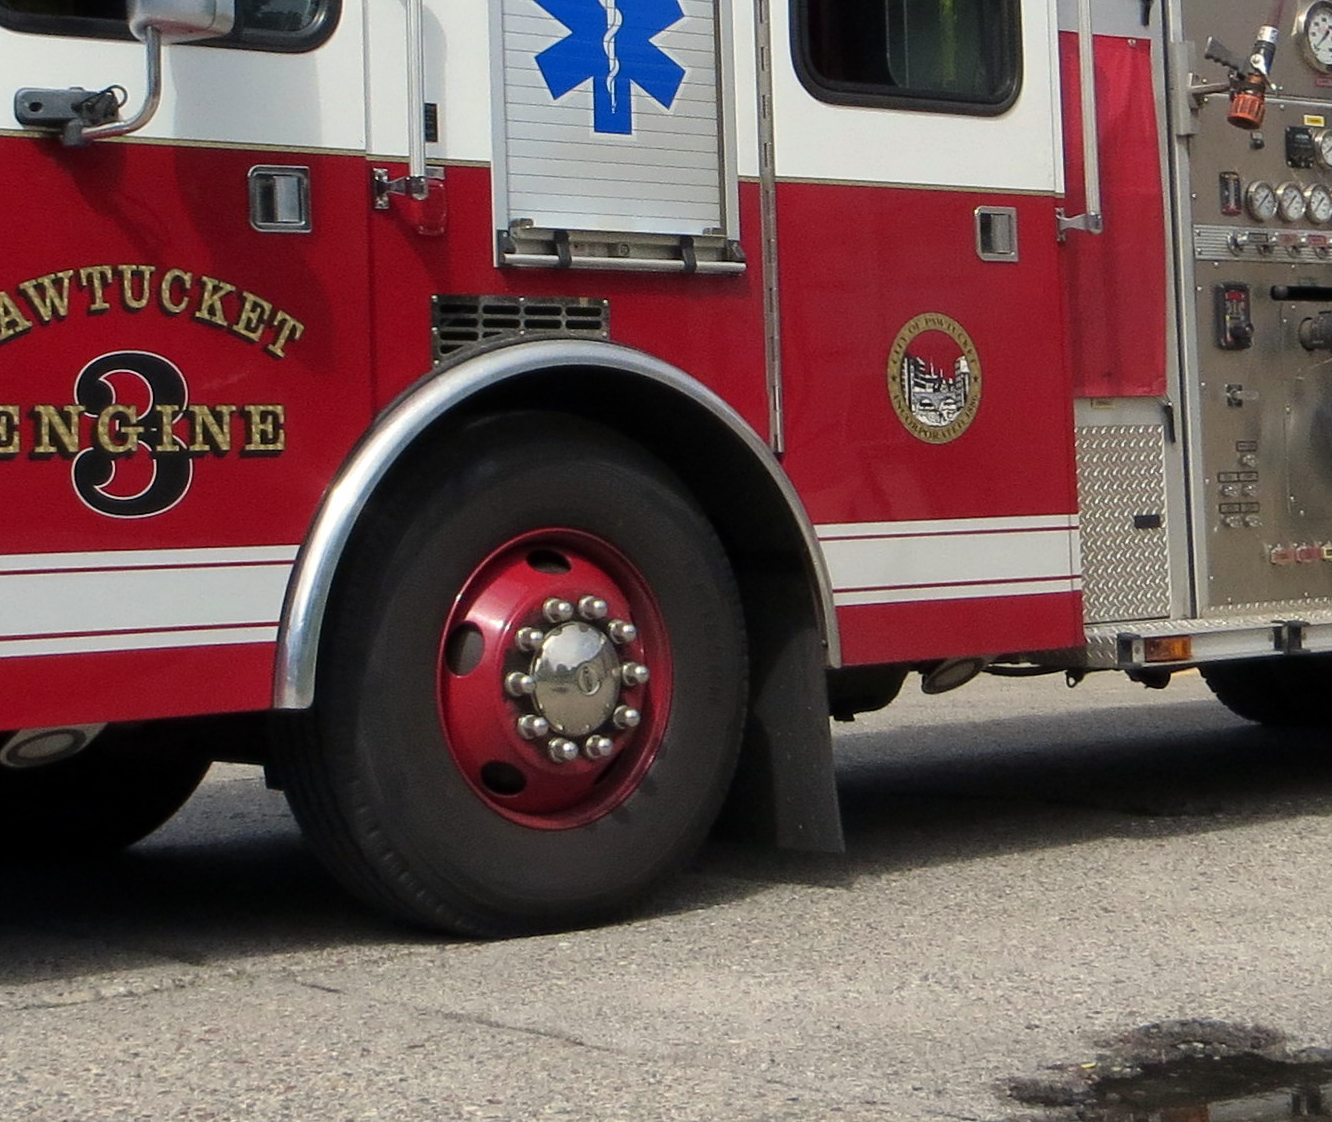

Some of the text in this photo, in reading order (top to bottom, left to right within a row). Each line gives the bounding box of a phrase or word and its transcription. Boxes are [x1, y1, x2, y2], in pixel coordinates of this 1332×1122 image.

[924, 316, 977, 363] PAWTUCKET
[71, 349, 193, 519] 3
[892, 394, 965, 441] INCORPORATED
